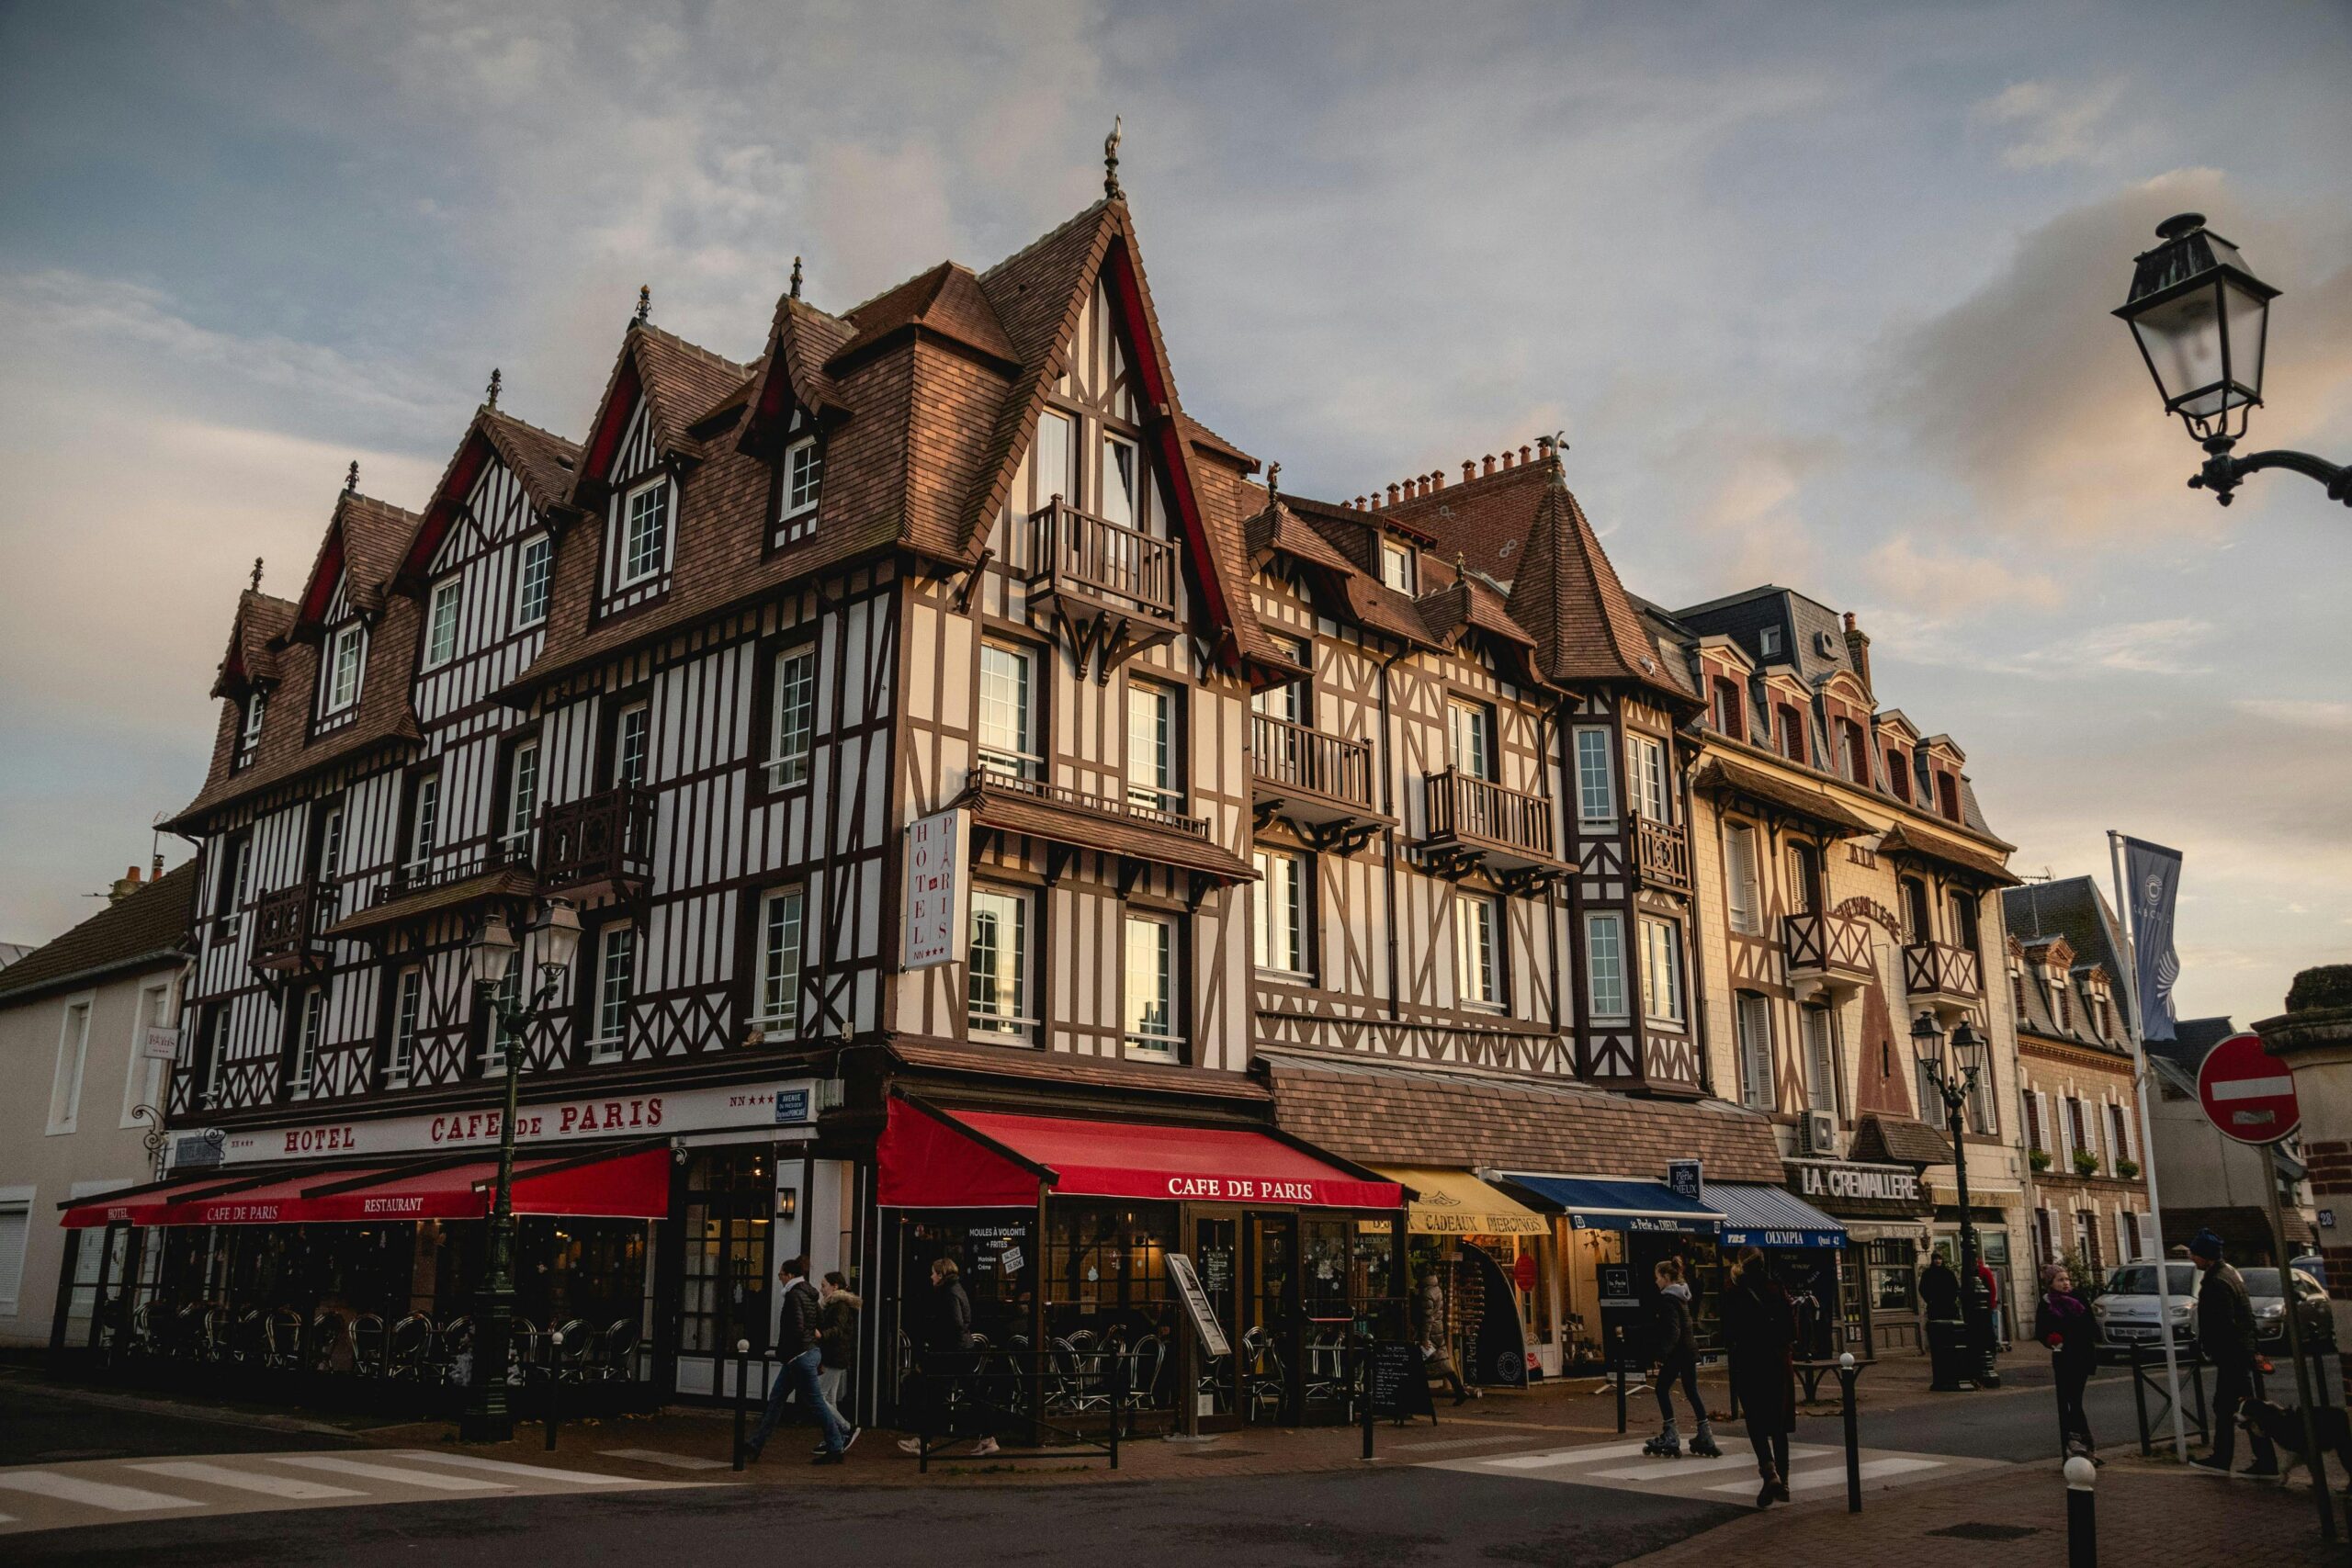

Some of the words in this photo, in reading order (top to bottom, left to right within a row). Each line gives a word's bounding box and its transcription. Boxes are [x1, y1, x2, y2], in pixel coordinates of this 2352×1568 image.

[729, 1096, 745, 1107] NN
[432, 1112, 500, 1143] CAFE
[516, 1117, 542, 1135] DE
[560, 1098, 662, 1134] PARIS
[285, 1127, 355, 1153] HOTEL
[1676, 1170, 1693, 1180] Perle
[1168, 1178, 1221, 1196] CAFE
[1227, 1180, 1254, 1198] DE
[1261, 1181, 1313, 1201] PARIS
[1672, 1184, 1697, 1194] DIEUX
[1802, 1168, 1824, 1195] LA
[1827, 1169, 1919, 1201] CREMAILLERE
[364, 1197, 424, 1213] RESTAURANT
[107, 1208, 129, 1220] HOTEL
[207, 1207, 231, 1221] CAFE
[232, 1206, 246, 1220] DE
[250, 1205, 278, 1220] PARIS
[2320, 1212, 2333, 1225] 28
[1426, 1213, 1477, 1232] CADEAUX
[1487, 1216, 1542, 1233] PIERCINGS
[1636, 1218, 1653, 1230] Perle
[1658, 1219, 1679, 1231] DIEUX
[969, 1227, 992, 1236] MOULES
[993, 1226, 998, 1236] À
[998, 1225, 1026, 1236] VOLONTÉ
[989, 1240, 1008, 1248] FRITES
[1765, 1231, 1804, 1245] OLYMPIA
[1818, 1235, 1830, 1246] Quai
[1833, 1235, 1839, 1246] 42
